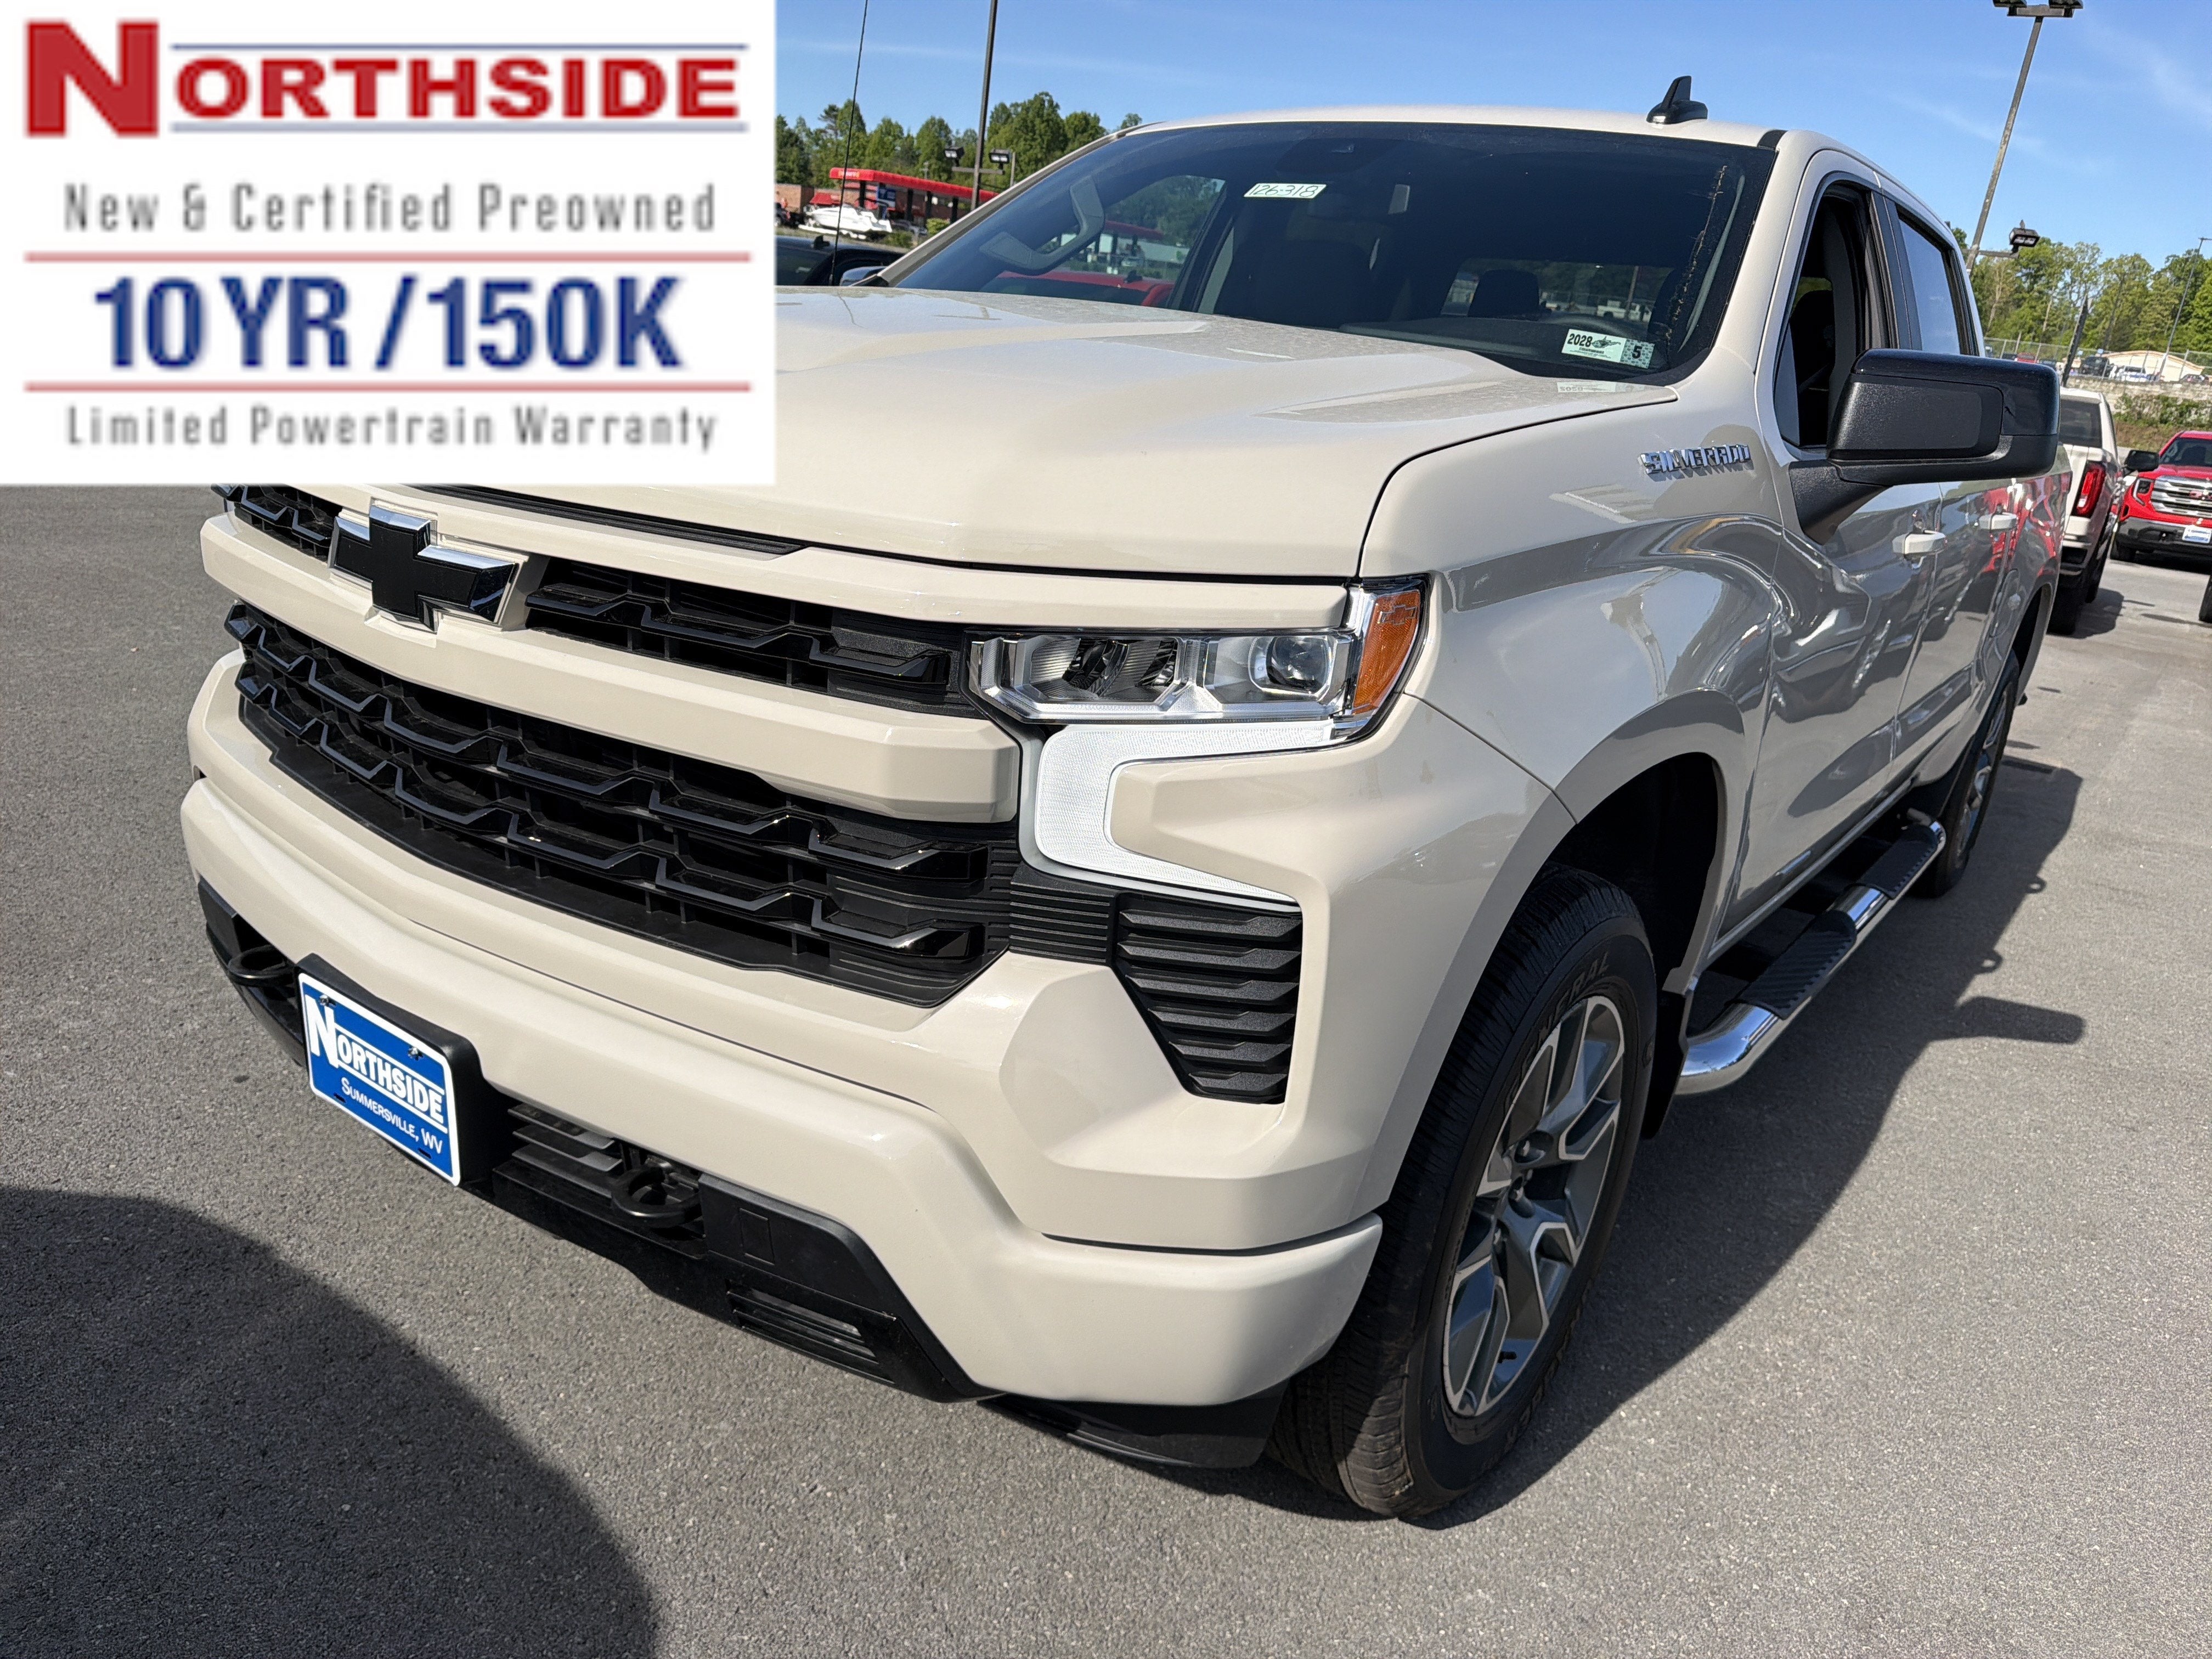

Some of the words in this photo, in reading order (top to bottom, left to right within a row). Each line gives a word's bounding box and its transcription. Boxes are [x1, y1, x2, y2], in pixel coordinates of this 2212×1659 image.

[1567, 333, 1593, 347] 2028
[1632, 345, 1643, 359] 5
[304, 994, 444, 1124] NORTHSIDE
[341, 1077, 419, 1142] SUMMERSVILLE,
[421, 1128, 442, 1154] WV
